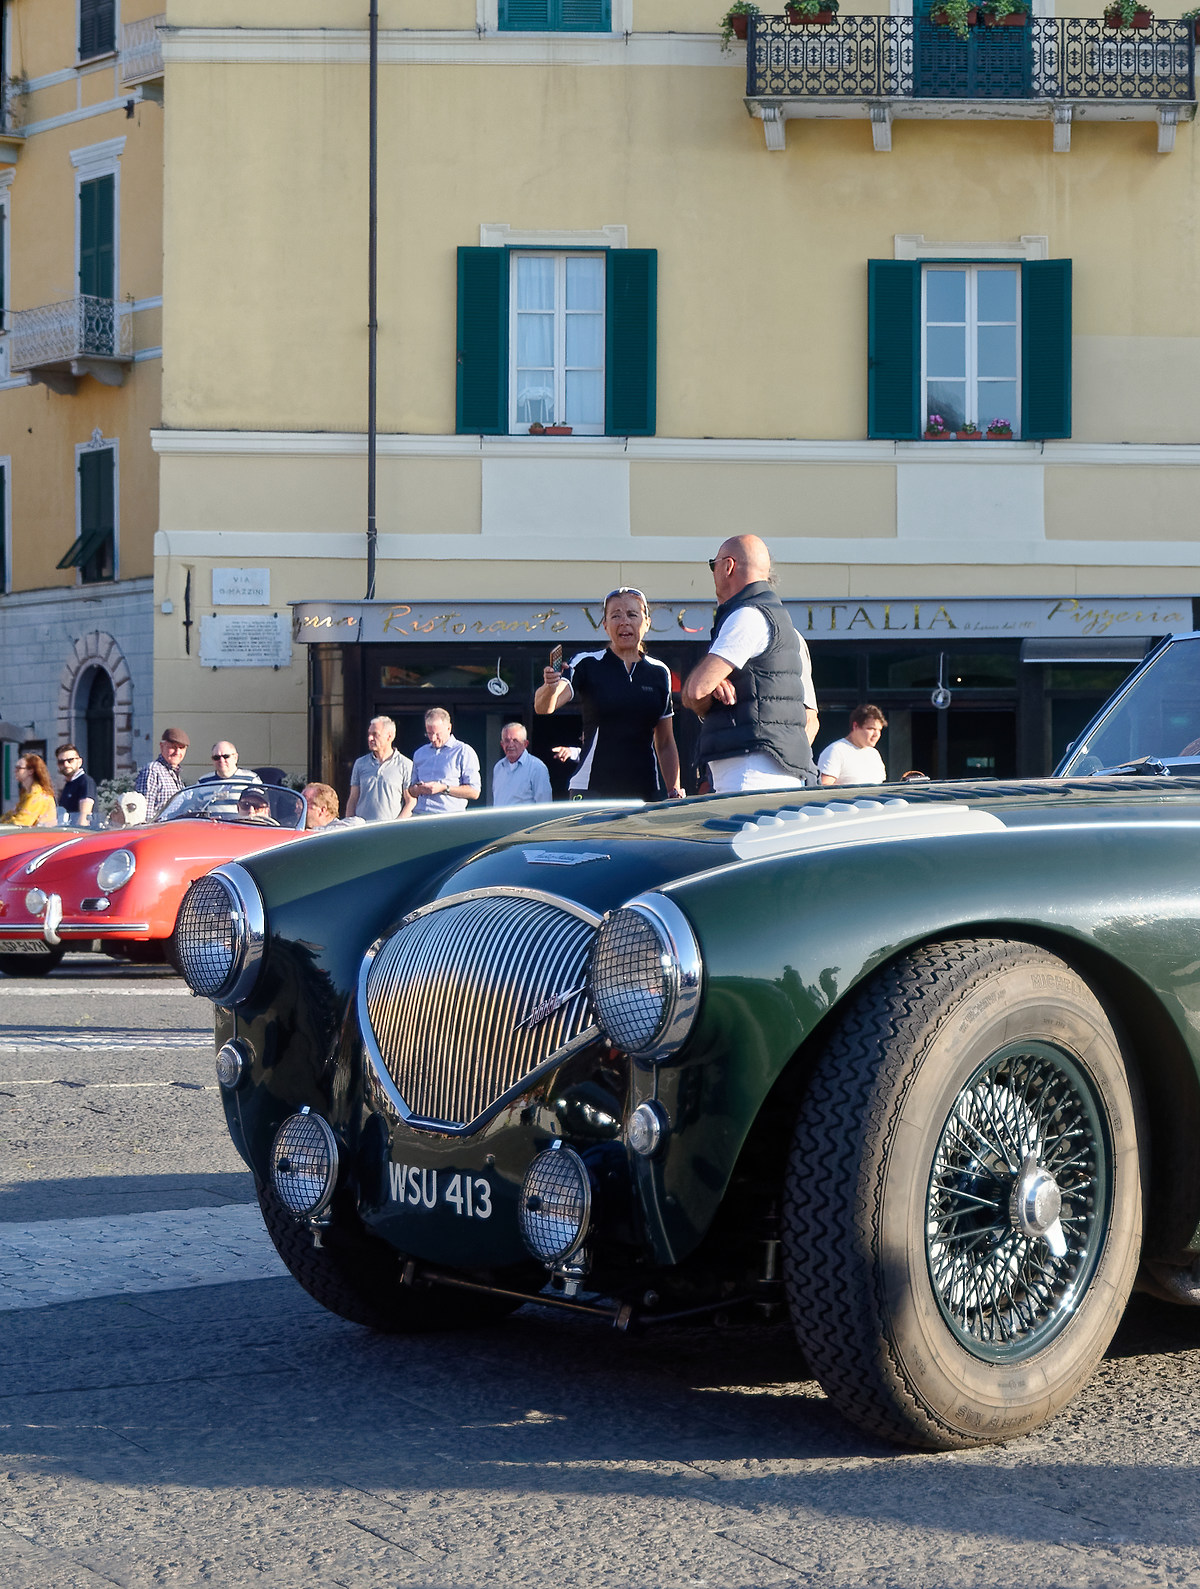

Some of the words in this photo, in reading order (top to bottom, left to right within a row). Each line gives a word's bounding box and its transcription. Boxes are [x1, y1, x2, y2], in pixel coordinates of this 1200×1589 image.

[380, 604, 569, 636] Ristorante
[804, 604, 957, 631] ITALIA
[1046, 599, 1184, 634] Pizzeria
[389, 1161, 437, 1209] WSU
[445, 1173, 492, 1219] 413
